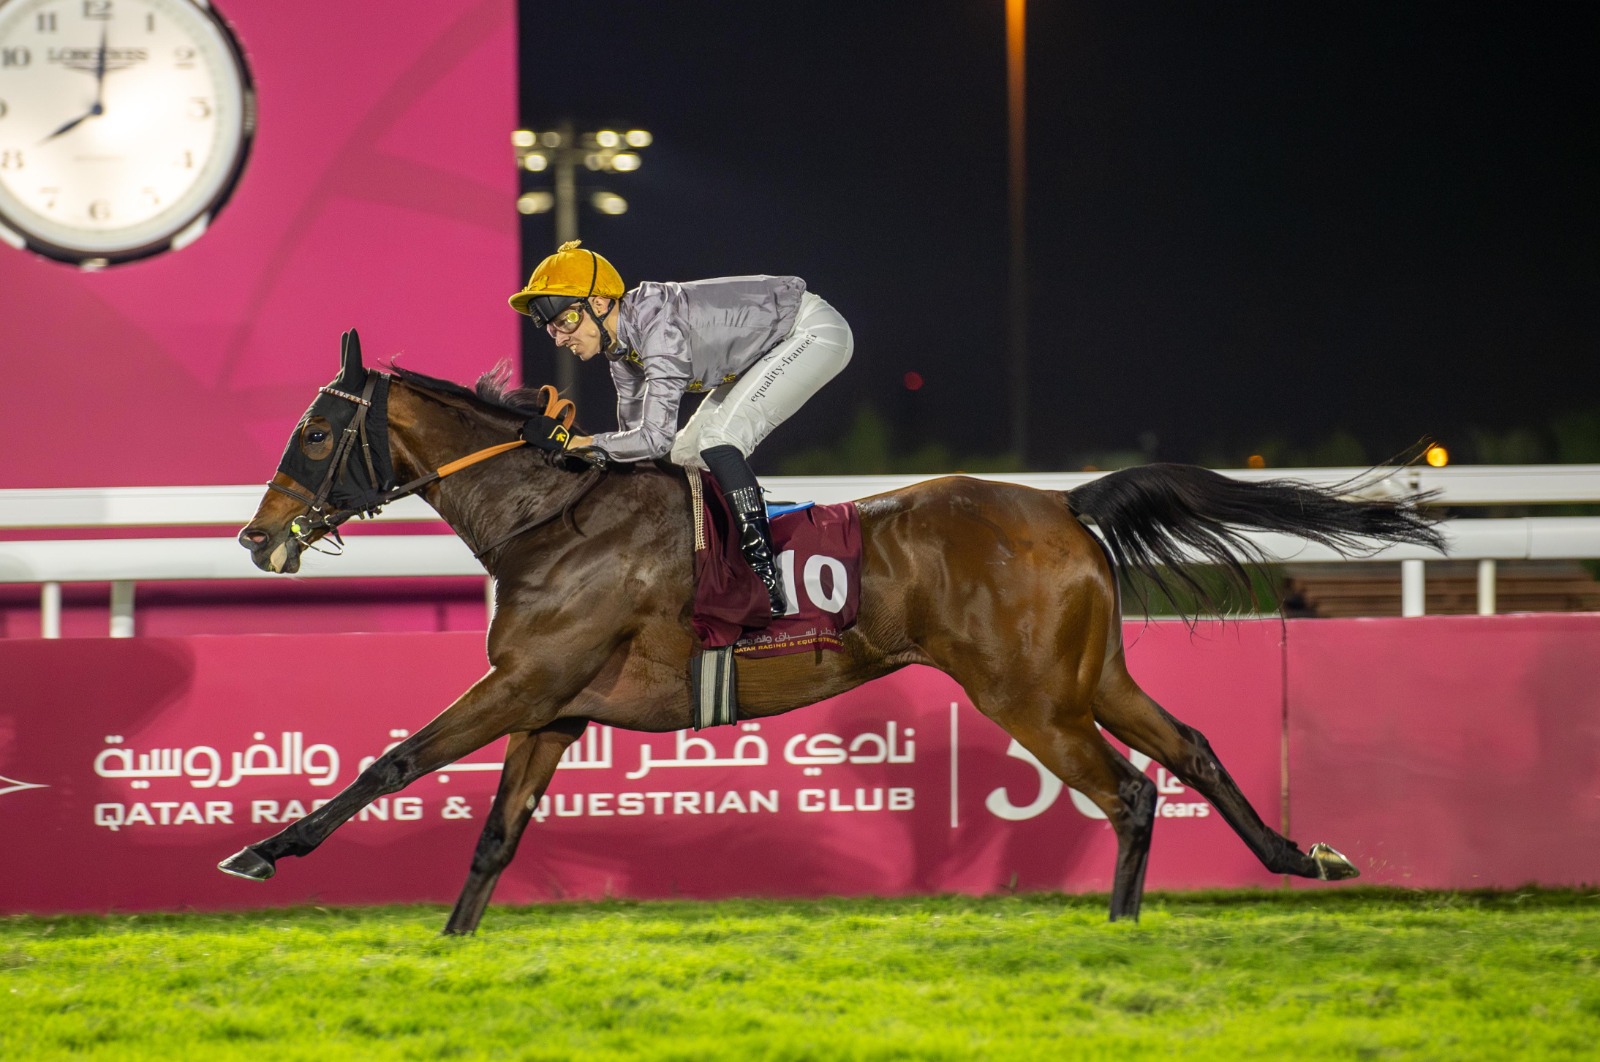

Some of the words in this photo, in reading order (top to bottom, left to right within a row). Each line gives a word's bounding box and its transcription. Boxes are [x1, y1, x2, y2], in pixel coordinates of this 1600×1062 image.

[37, 13, 57, 32] 11
[2, 48, 31, 66] 10
[47, 47, 149, 62] LONGNES
[776, 549, 848, 617] 10
[758, 642, 787, 651] RACING
[94, 731, 340, 789] والفروسية
[626, 722, 769, 780] قطر
[784, 721, 915, 777] نادي
[95, 801, 234, 831] QATAR
[251, 797, 424, 824] RANG
[440, 796, 472, 820] &
[491, 789, 780, 822] QUESTRIAN
[797, 787, 915, 813] CLUB
